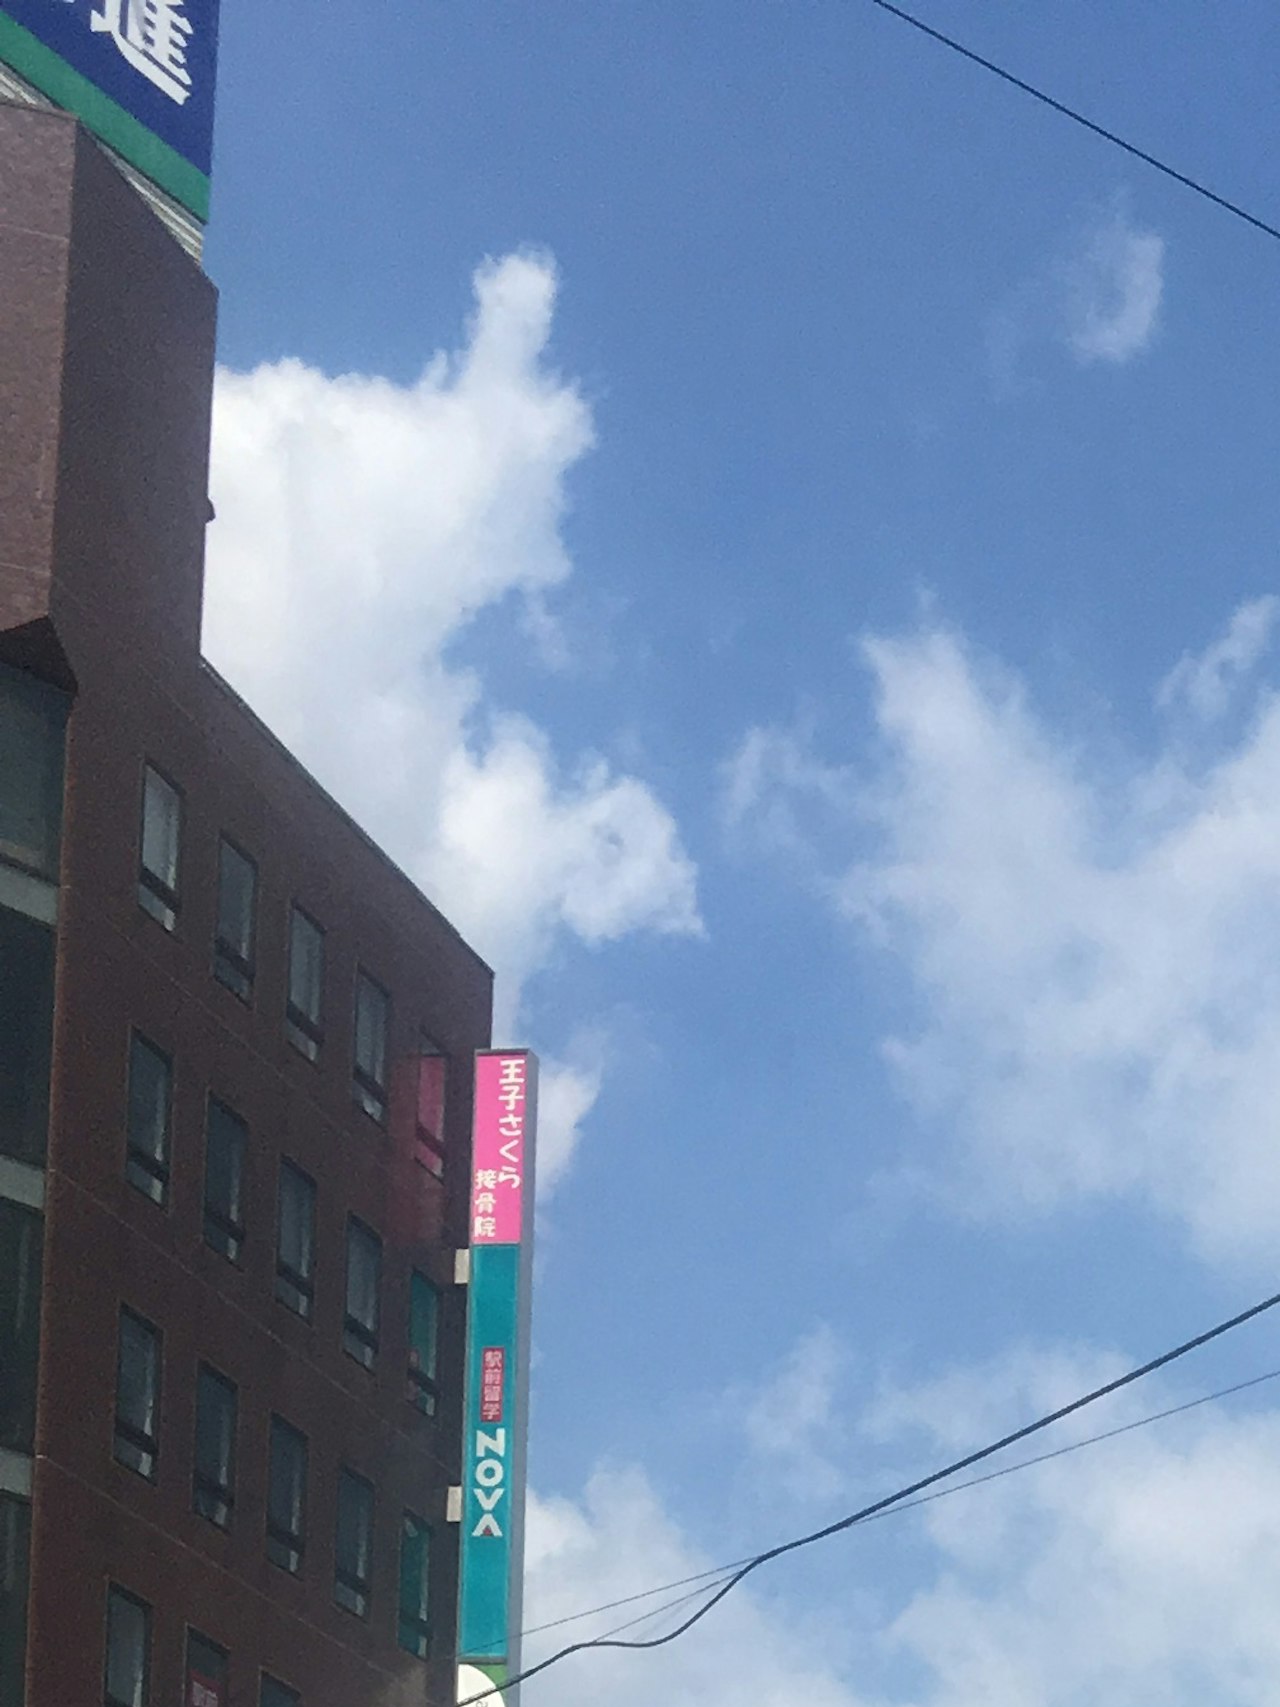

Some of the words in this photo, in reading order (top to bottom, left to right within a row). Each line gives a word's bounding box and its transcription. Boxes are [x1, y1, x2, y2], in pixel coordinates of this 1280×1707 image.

[499, 1059, 524, 1189] 王子さくら
[474, 1169, 497, 1238] 接骨院
[472, 1428, 505, 1537] NOVA
